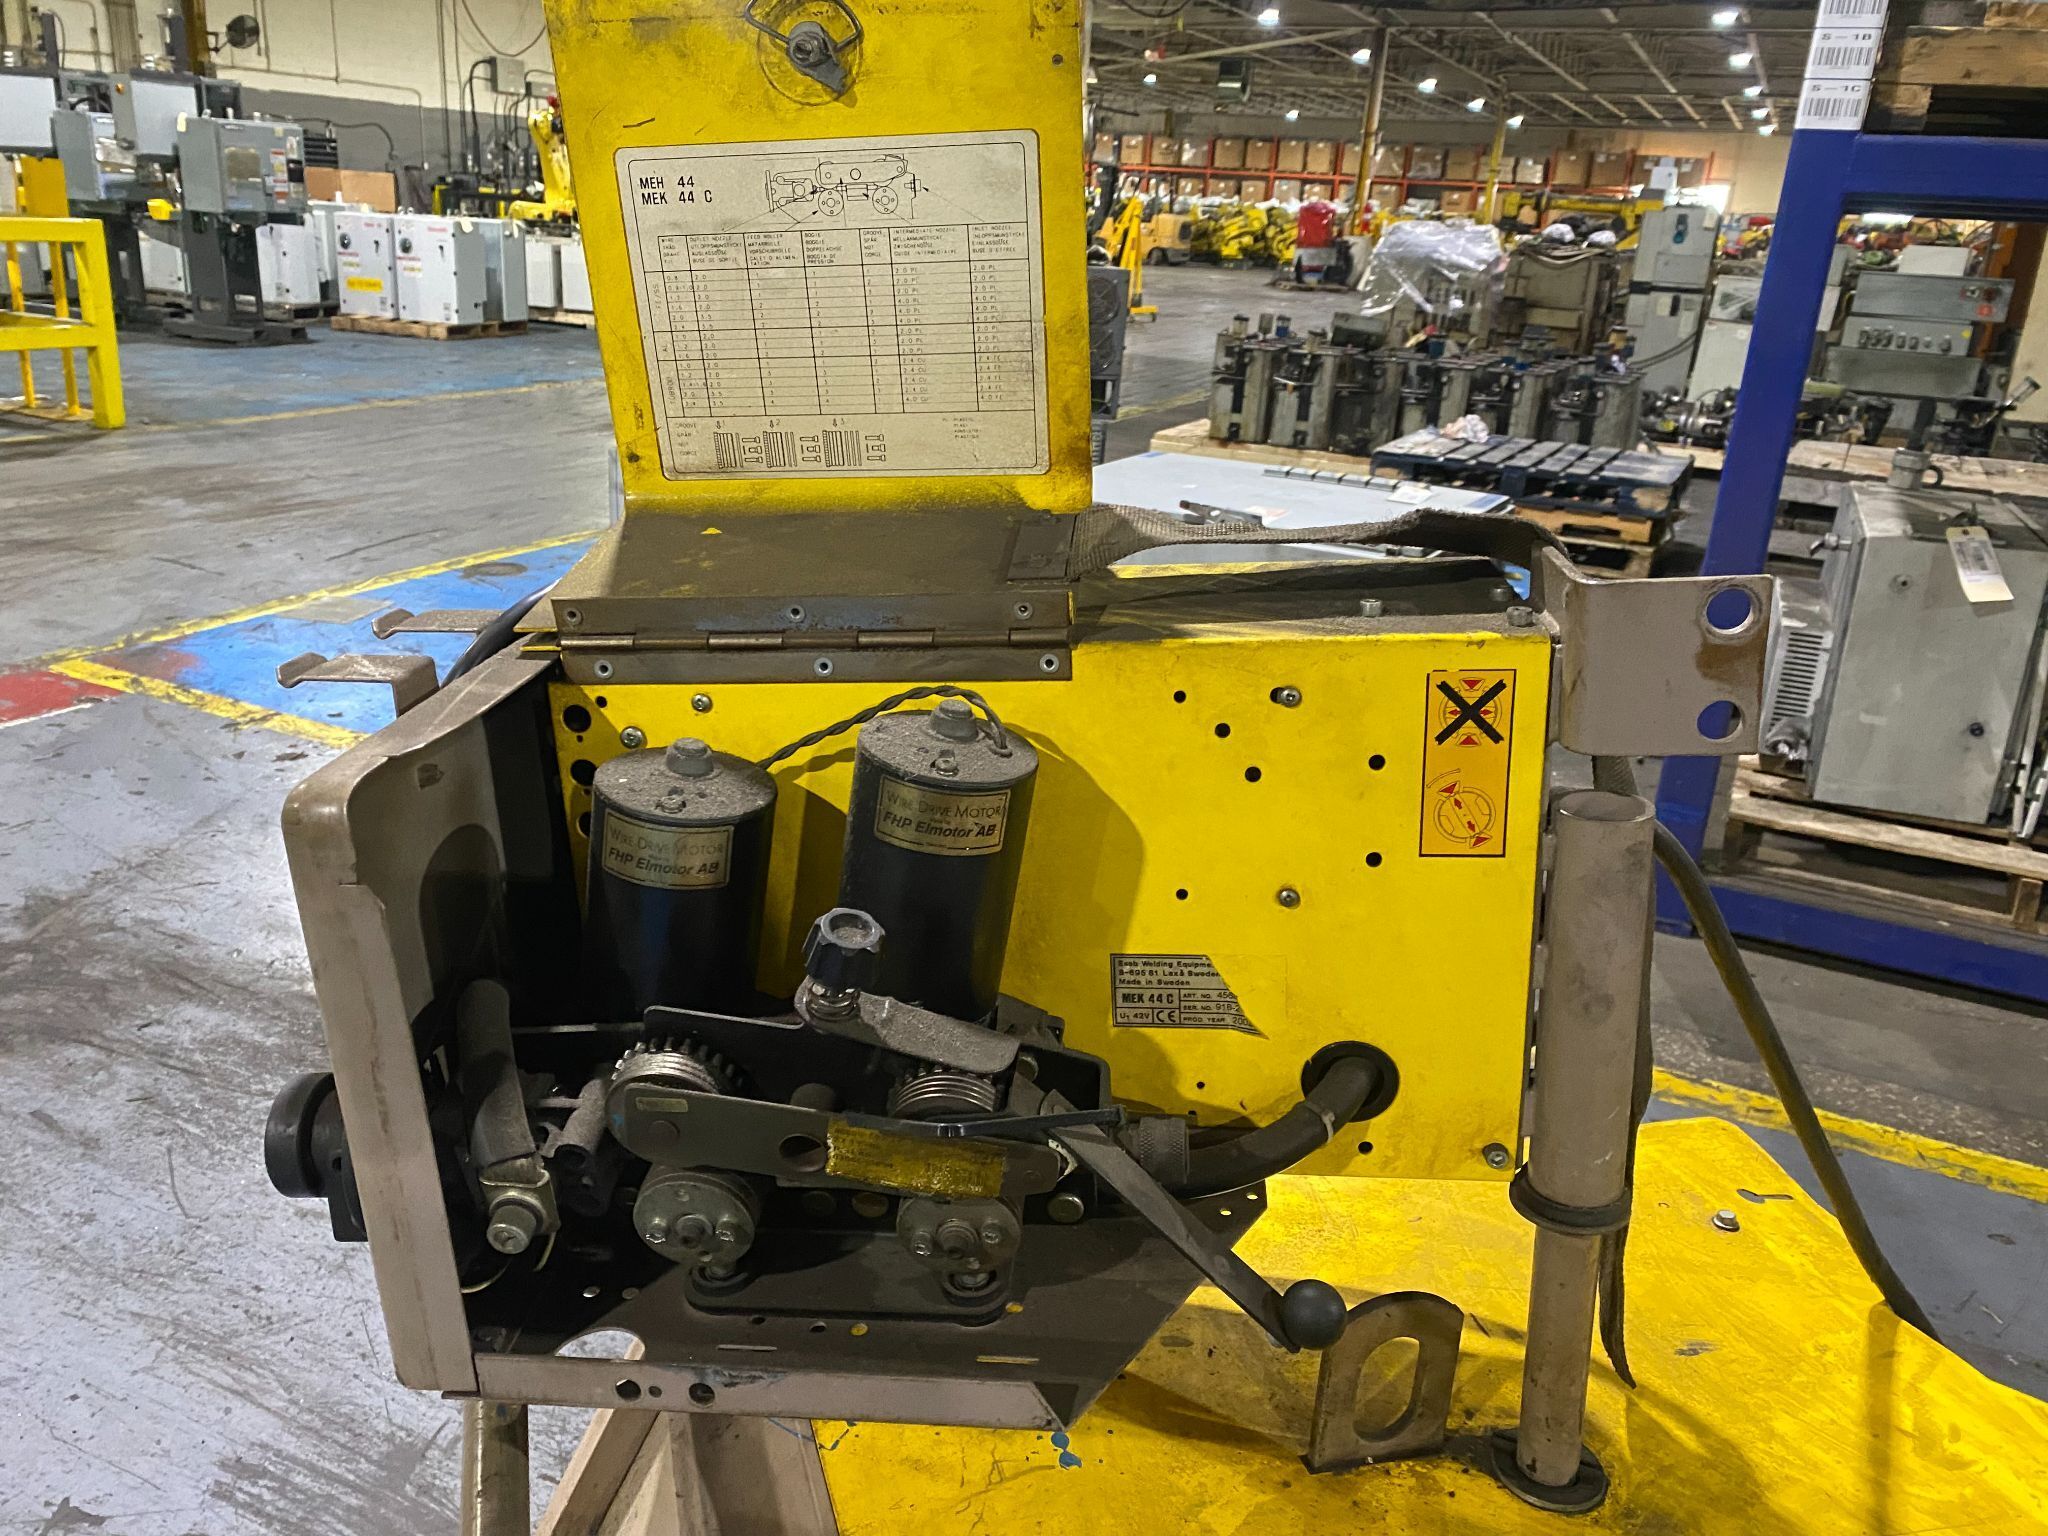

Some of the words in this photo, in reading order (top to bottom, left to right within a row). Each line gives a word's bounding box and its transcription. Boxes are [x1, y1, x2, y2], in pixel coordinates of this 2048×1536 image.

[640, 177, 664, 189] MEH
[678, 176, 694, 187] 44
[642, 192, 667, 205] MEK
[679, 191, 694, 203] 44
[704, 190, 712, 202] C
[882, 811, 912, 828] FHP
[915, 821, 974, 838] Elmotor
[975, 823, 997, 837] AB
[608, 847, 634, 865] FHP
[635, 857, 694, 875] Elmotor
[697, 861, 719, 875] AB
[1177, 960, 1213, 968] Equipme
[1122, 993, 1145, 1004] MEK
[1149, 993, 1163, 1004] 44
[1166, 993, 1174, 1004] C
[1133, 1012, 1150, 1020] 42V
[1156, 1010, 1176, 1023] CE
